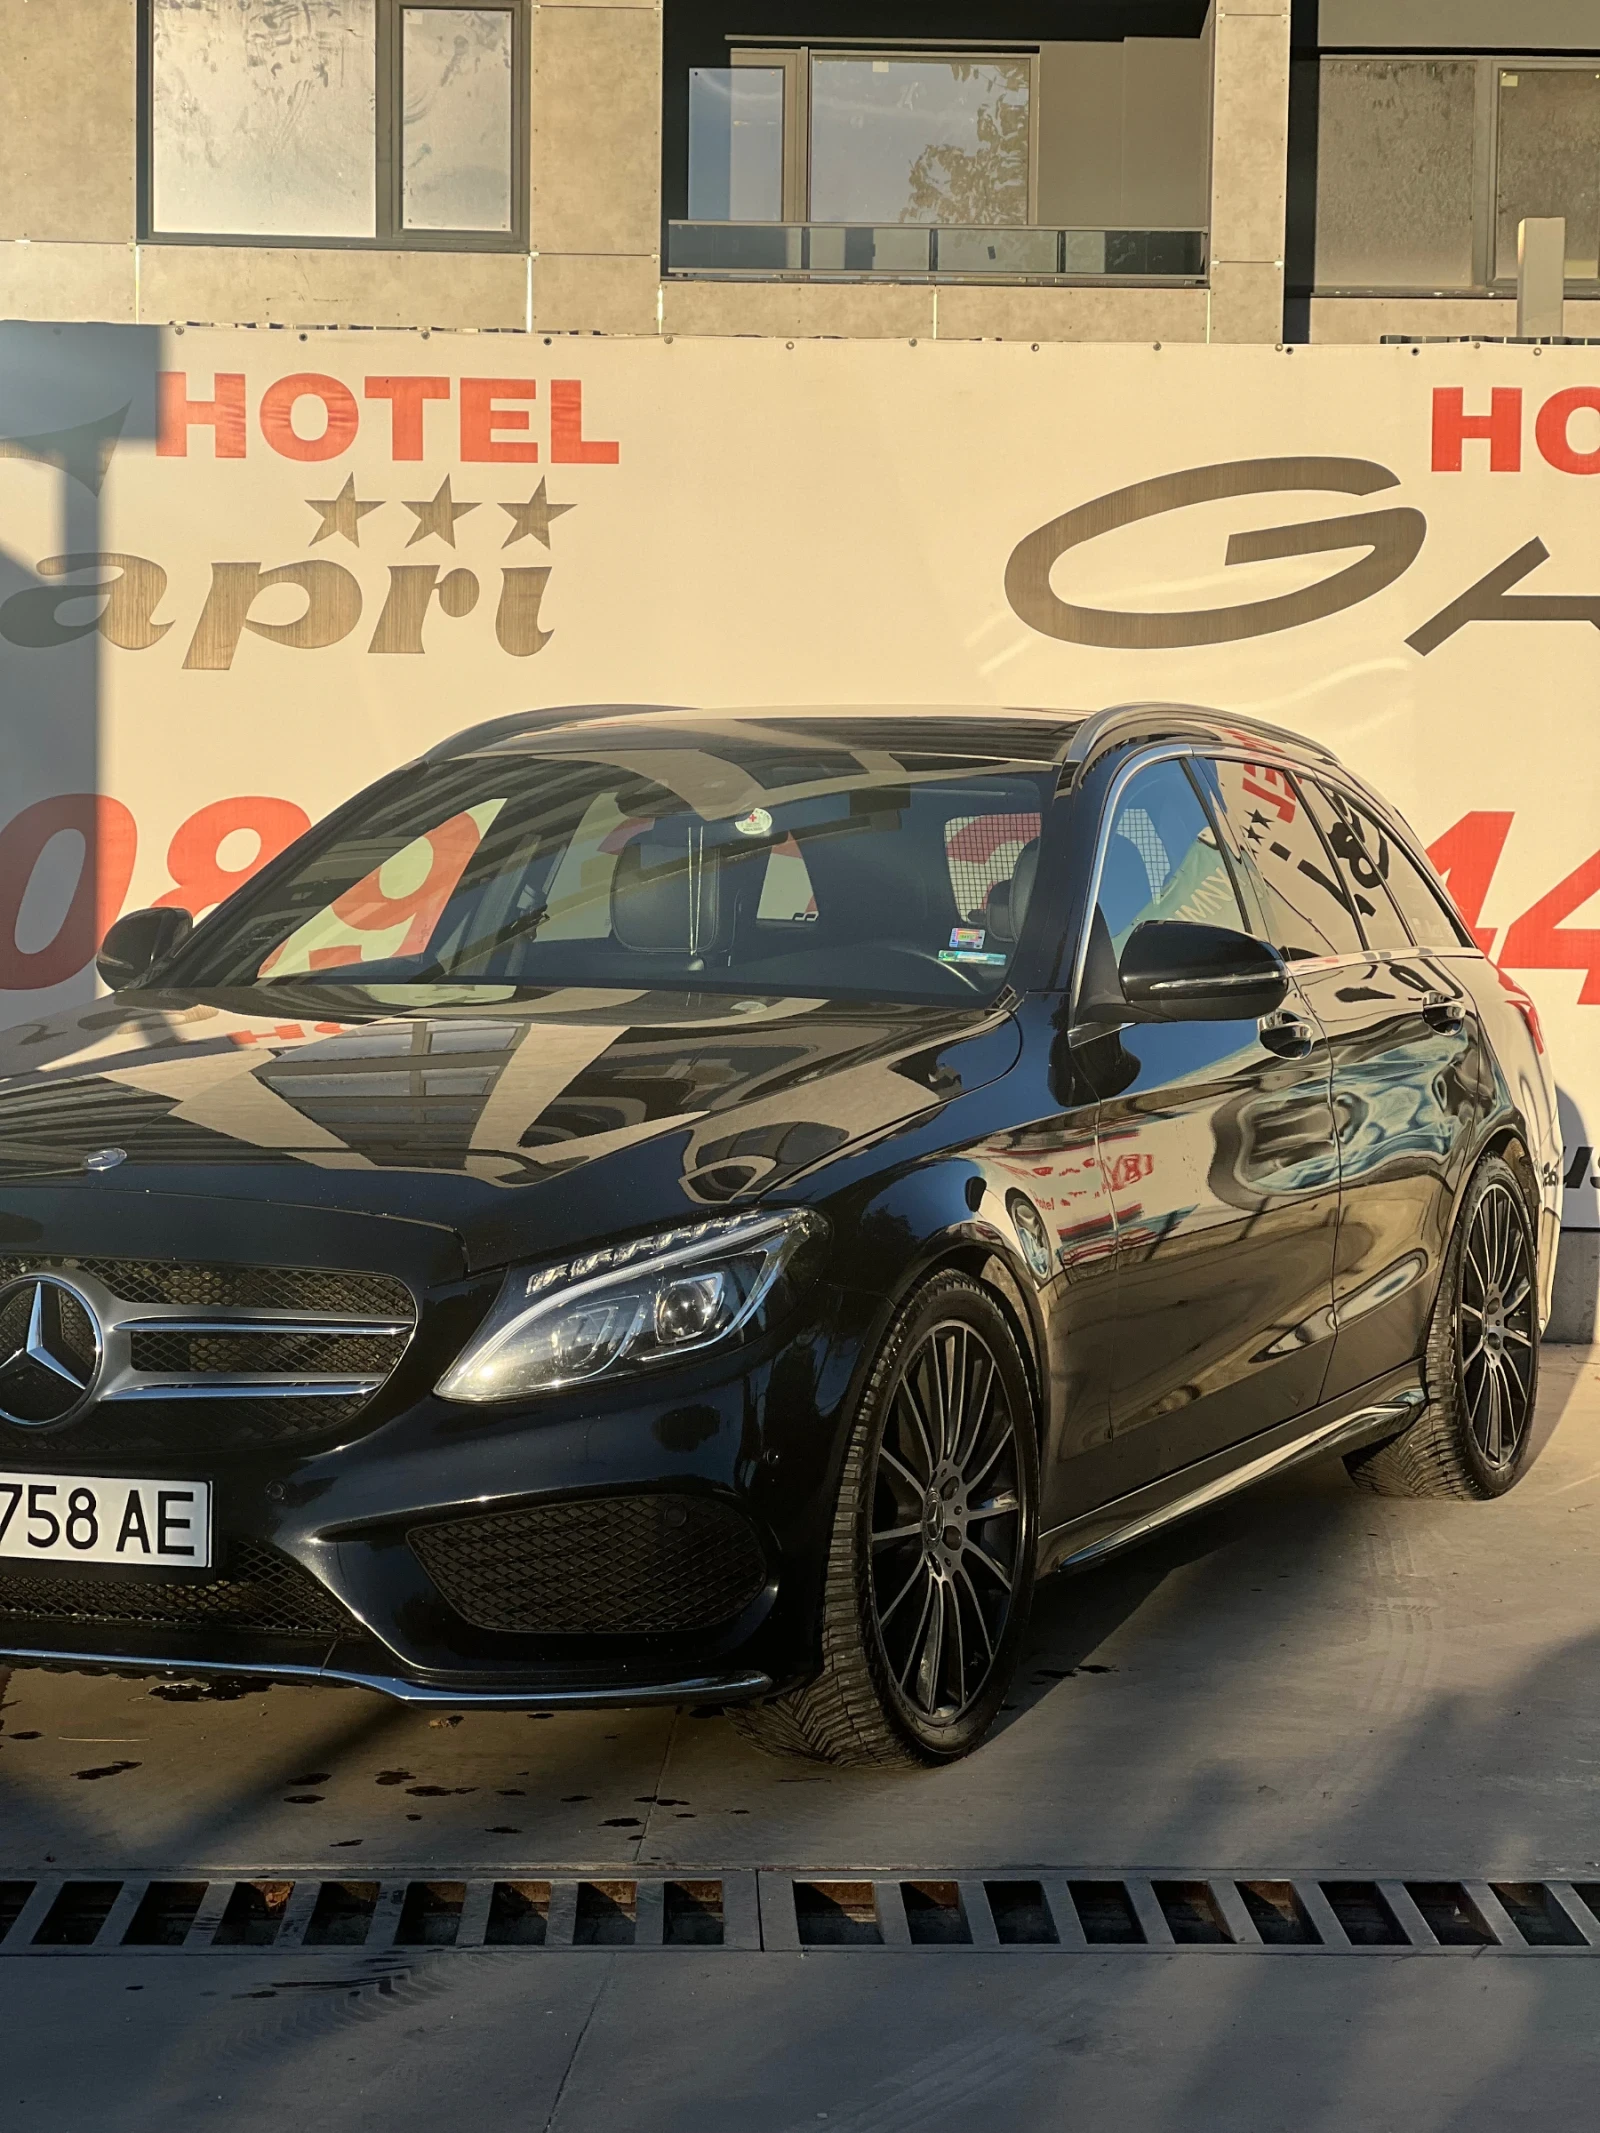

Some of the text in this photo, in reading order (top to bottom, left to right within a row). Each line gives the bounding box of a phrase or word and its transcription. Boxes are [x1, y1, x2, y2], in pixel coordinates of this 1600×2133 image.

[155, 371, 619, 465] HOTEL
[0, 1483, 195, 1556] 758 AE
